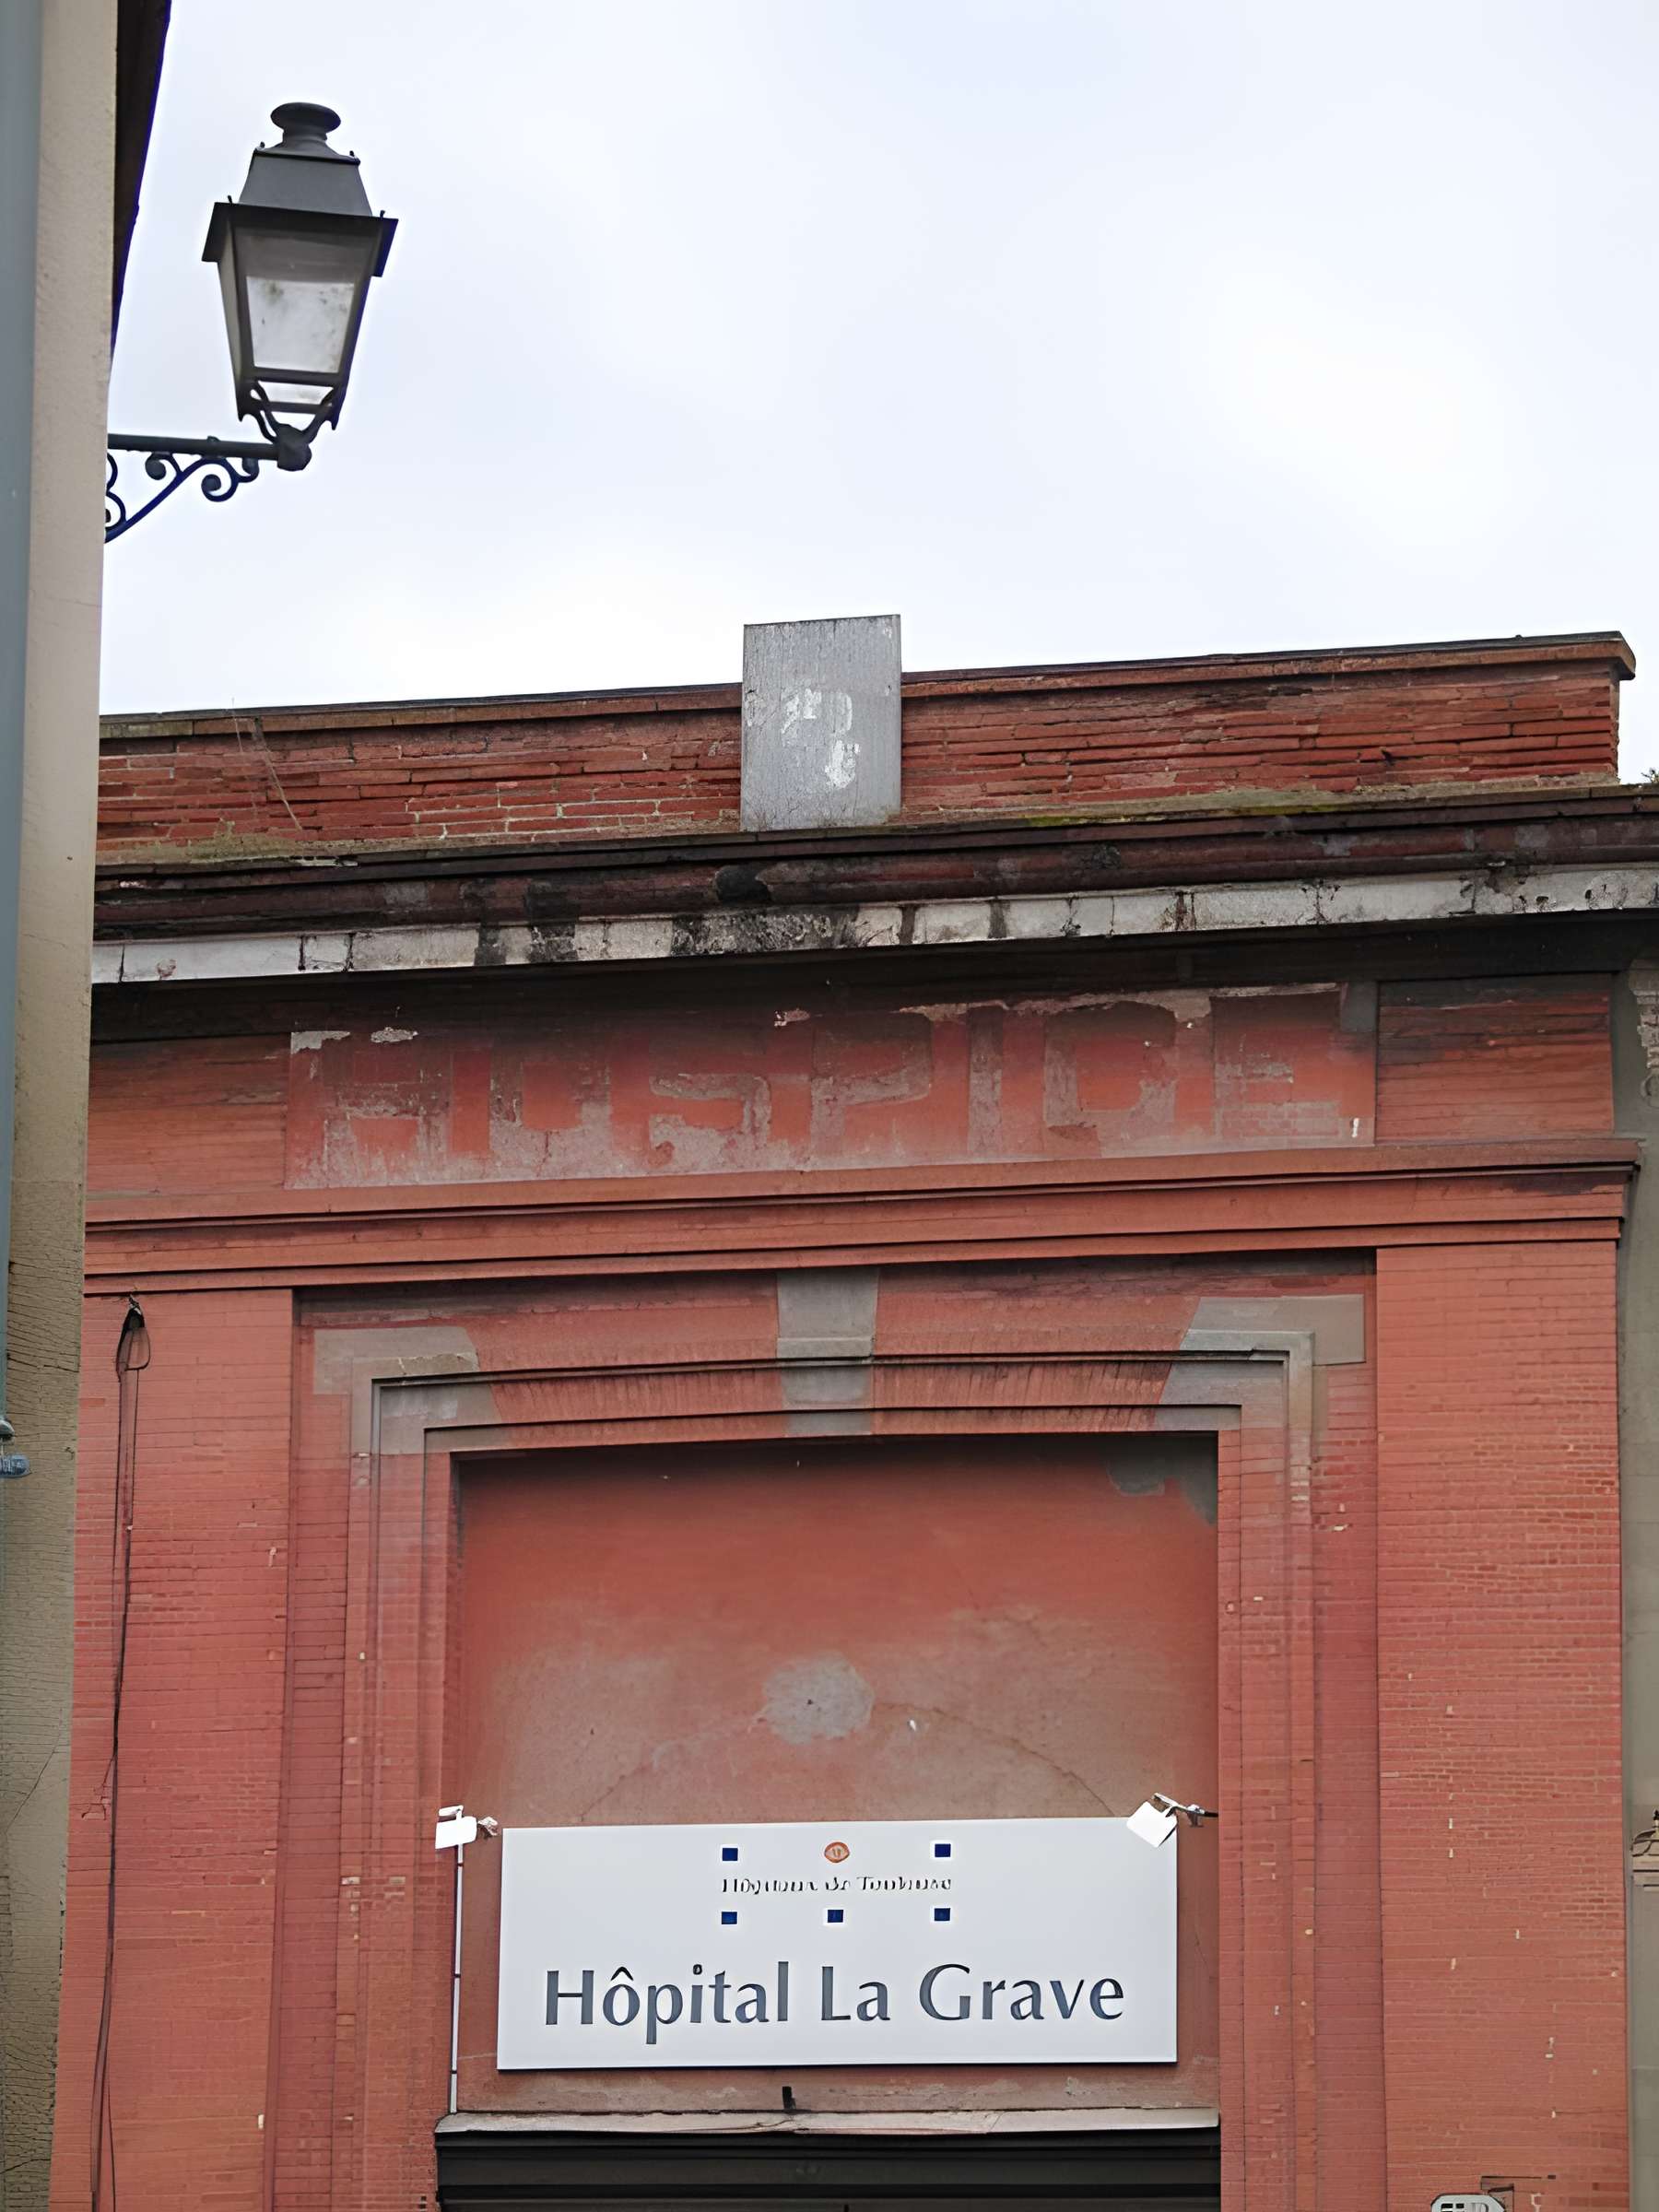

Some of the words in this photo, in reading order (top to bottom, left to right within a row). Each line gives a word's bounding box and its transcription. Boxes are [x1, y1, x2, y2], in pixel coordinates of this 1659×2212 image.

[546, 1961, 789, 2044] Hôpital
[821, 1966, 890, 2021] La
[919, 1963, 1124, 2021] Grave
